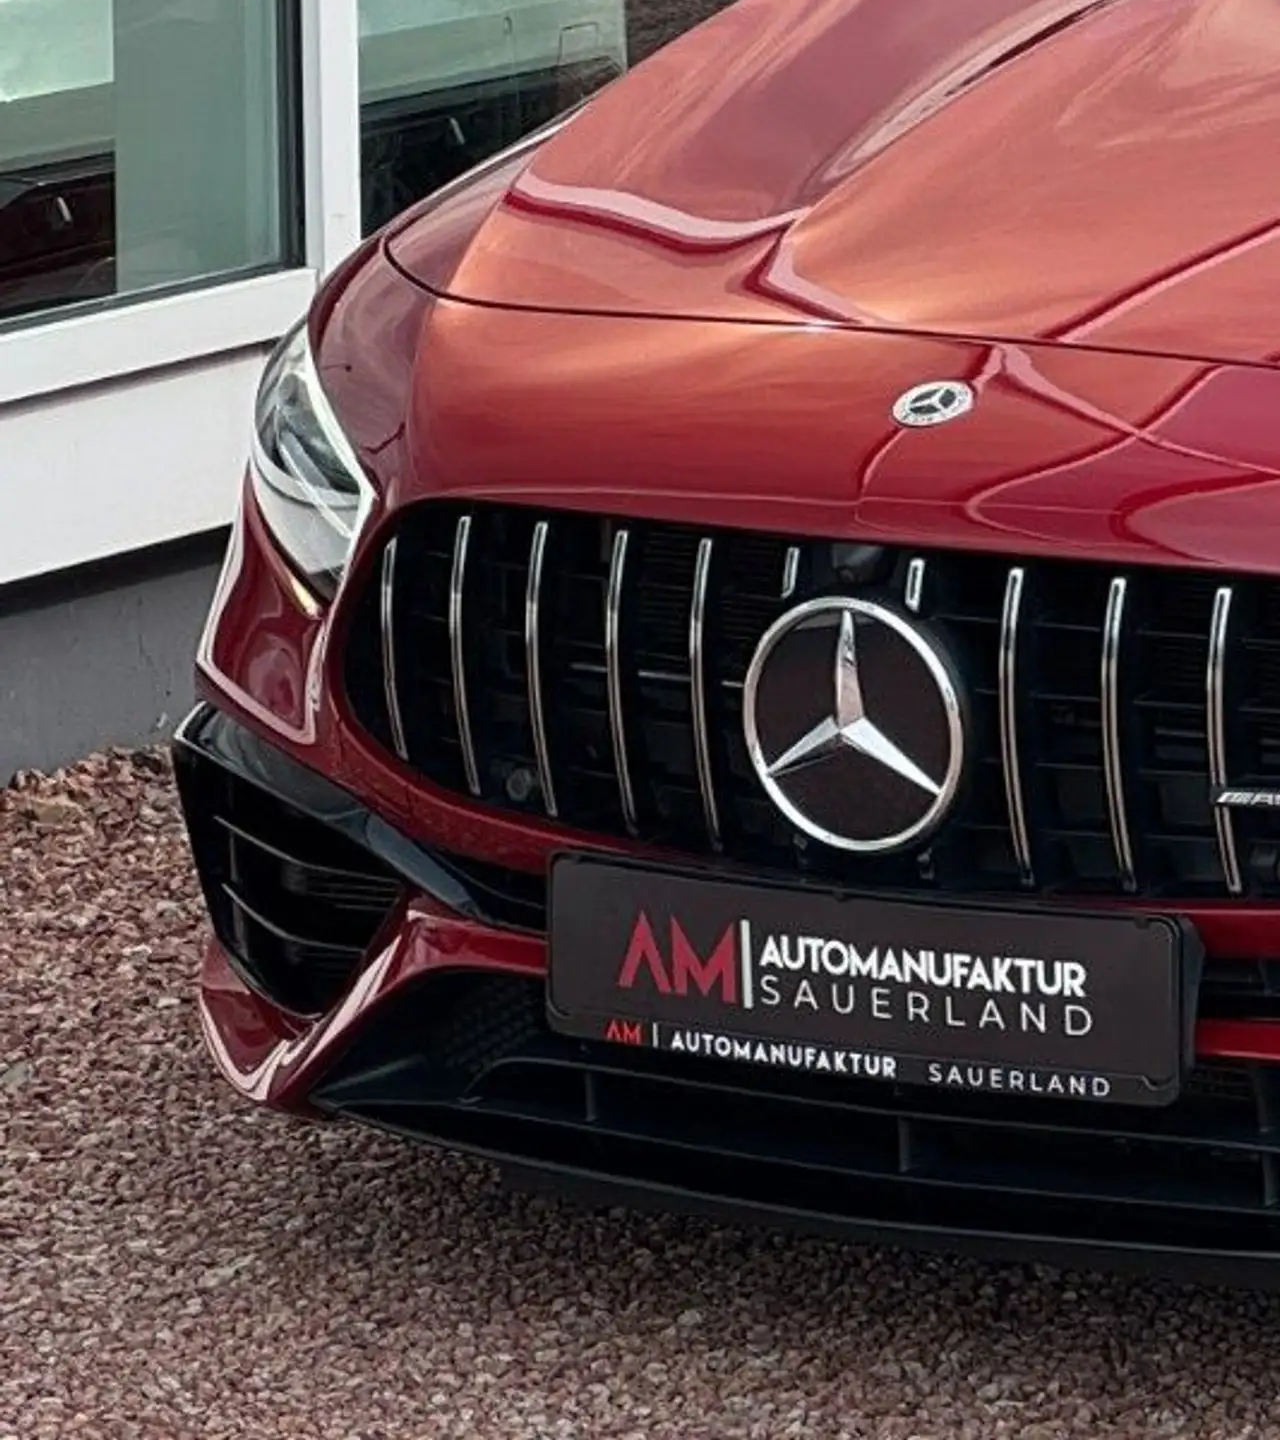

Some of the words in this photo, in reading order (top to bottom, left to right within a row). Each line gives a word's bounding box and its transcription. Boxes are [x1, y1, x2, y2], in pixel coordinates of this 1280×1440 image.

[618, 909, 737, 1005] AM
[759, 936, 1087, 999] AUTOMANUFAKTUR
[759, 974, 1094, 1037] SAUERLAND
[603, 1020, 643, 1045] AM
[671, 1030, 898, 1080] AUTOMANUFAKTUR
[928, 1062, 1111, 1097] SAUERLAND
